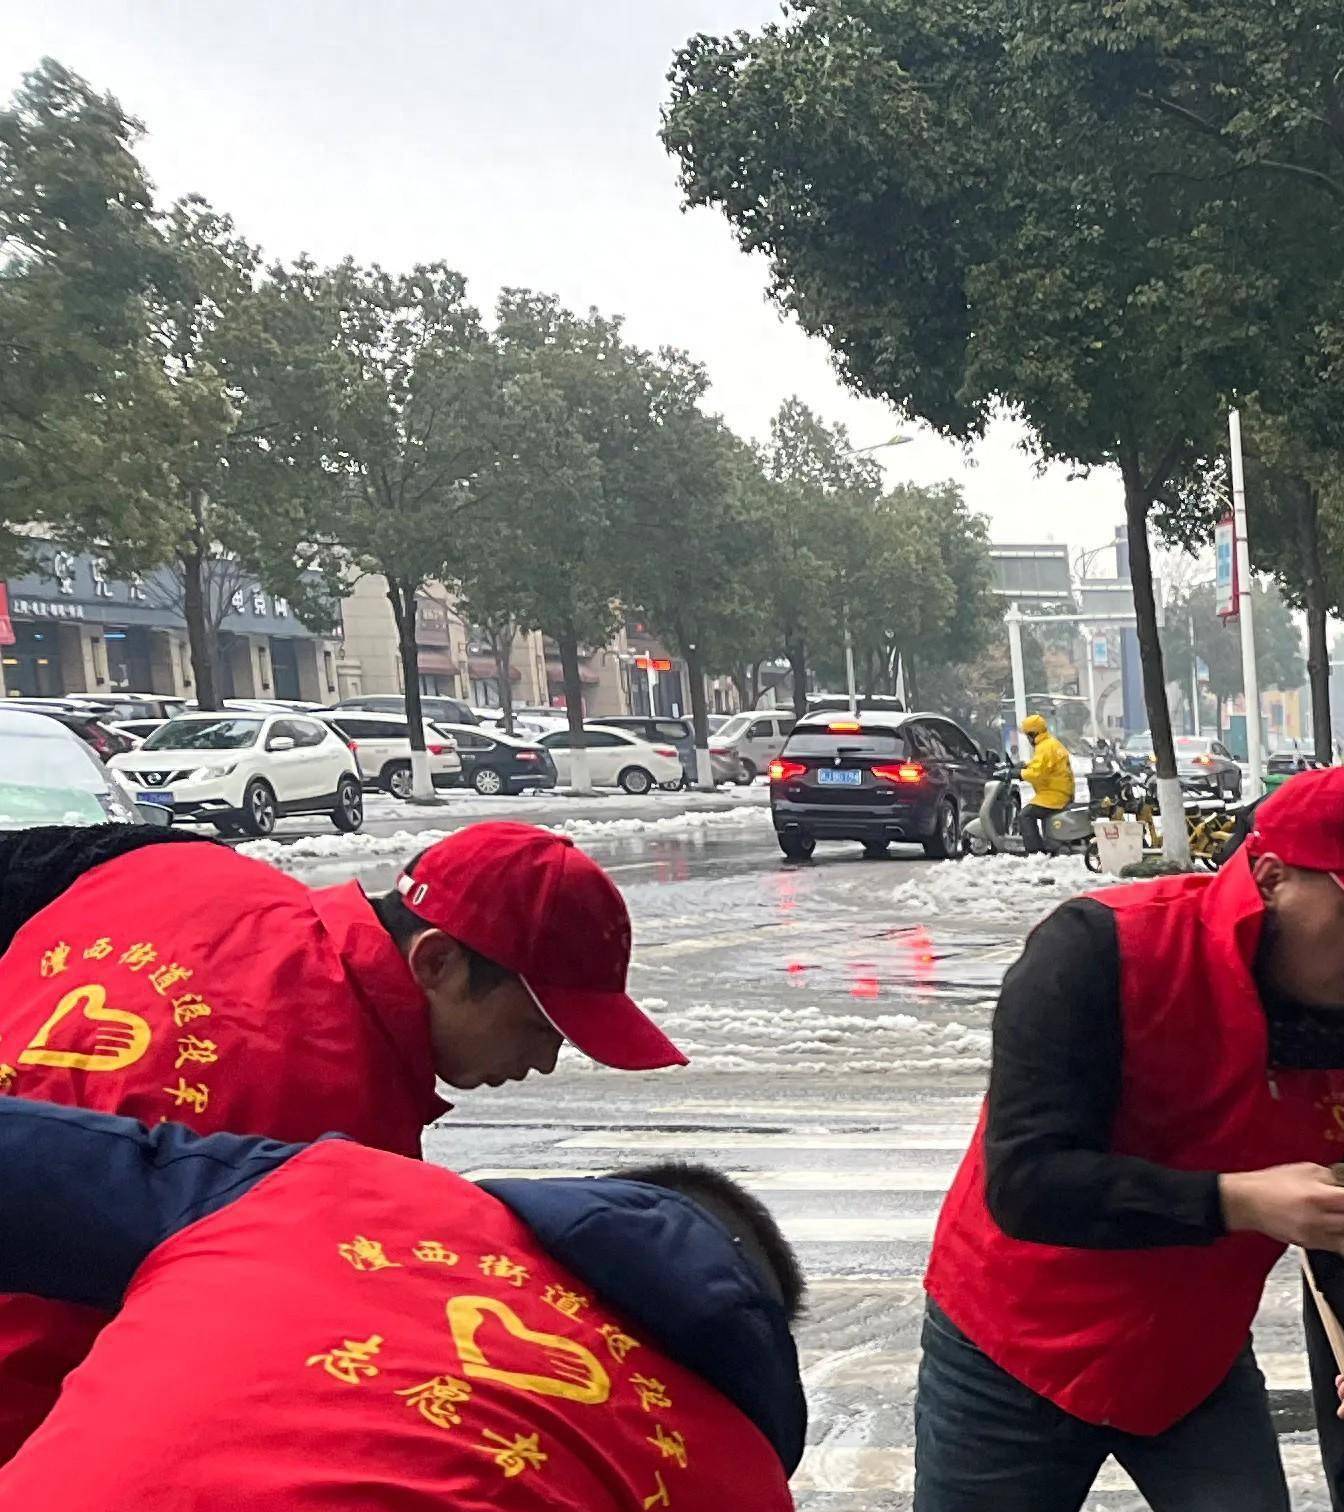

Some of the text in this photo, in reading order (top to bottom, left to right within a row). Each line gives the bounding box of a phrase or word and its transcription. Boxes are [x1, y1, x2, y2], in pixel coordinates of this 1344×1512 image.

[40, 936, 219, 1123] 澧西街道退役军
